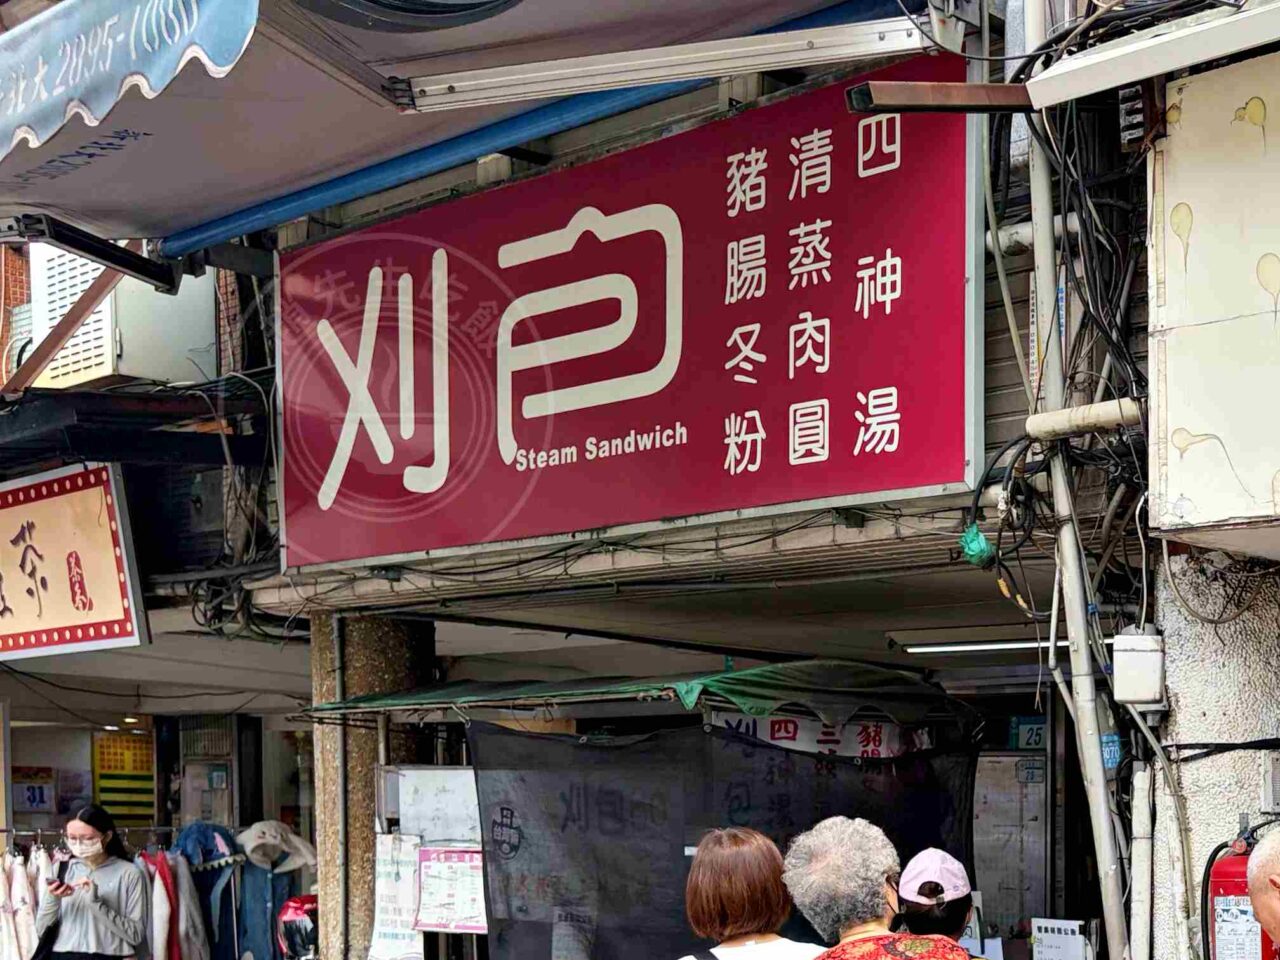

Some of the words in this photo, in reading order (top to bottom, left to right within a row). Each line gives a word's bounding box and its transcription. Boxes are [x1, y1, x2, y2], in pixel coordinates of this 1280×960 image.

[317, 202, 684, 511] 刈包
[723, 149, 768, 476] 豬腸冬粉
[788, 127, 833, 466] 清蒸肉圓
[853, 113, 903, 458] 四神湯
[515, 445, 578, 472] Steam
[585, 421, 688, 461] Sandwich
[1026, 727, 1043, 746] 25
